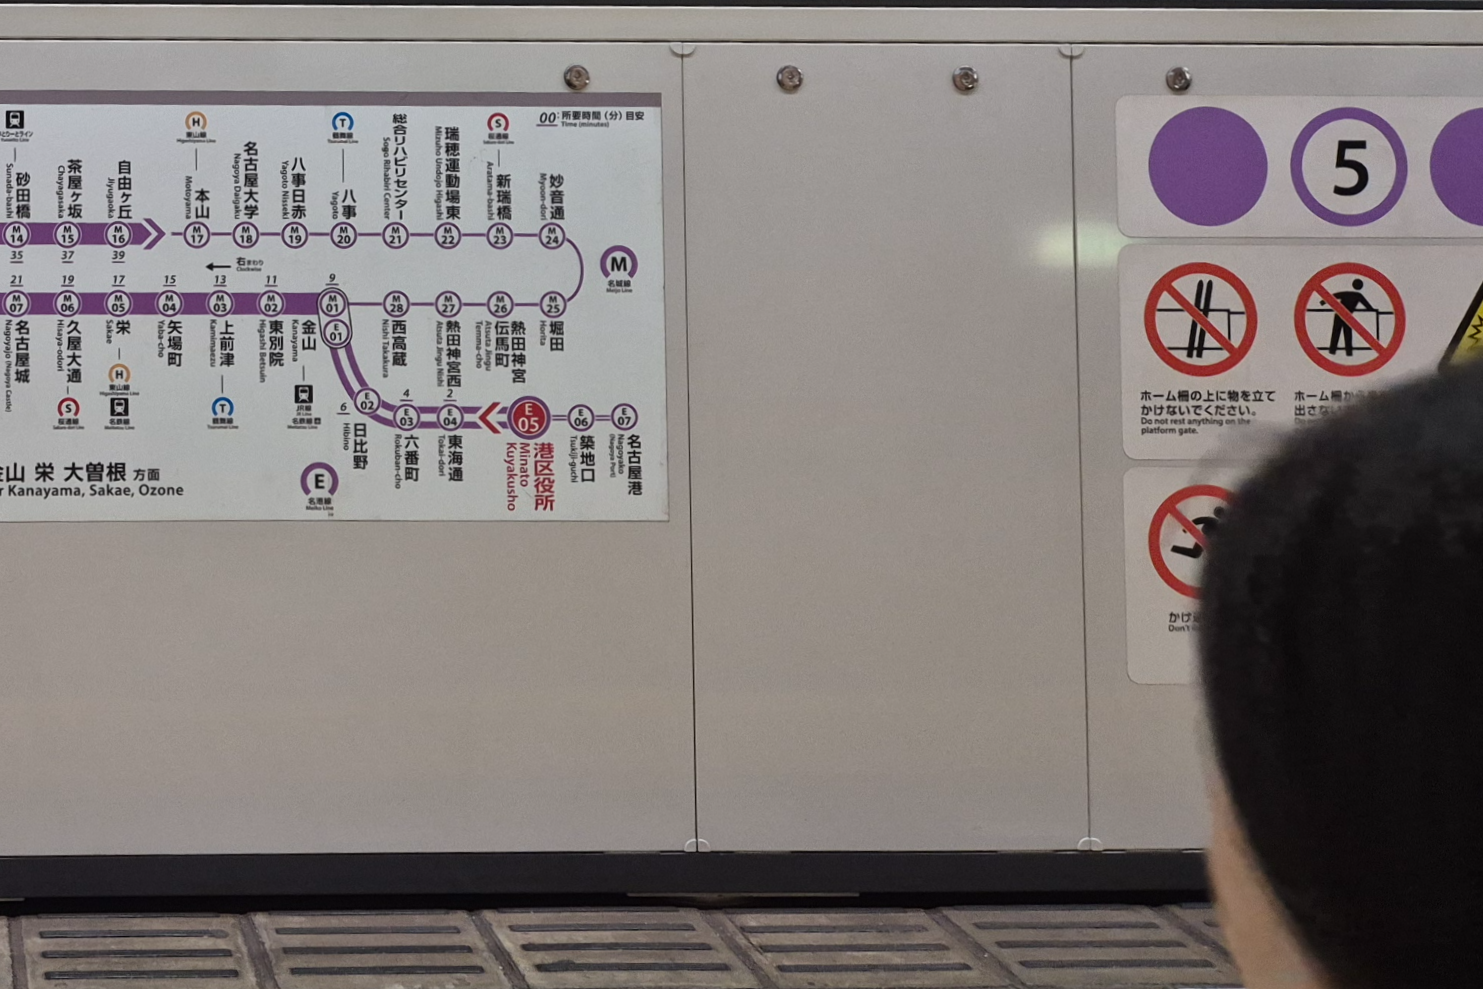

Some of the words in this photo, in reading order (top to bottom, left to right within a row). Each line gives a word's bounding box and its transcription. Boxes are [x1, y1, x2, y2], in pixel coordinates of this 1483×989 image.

[193, 117, 200, 126] H
[339, 118, 346, 127] T
[495, 119, 502, 128] S
[232, 153, 241, 185] Nagoya
[243, 141, 259, 219] 名古屋大学
[280, 160, 289, 189] Yagoto
[392, 114, 408, 220] 総合リハビリセンター
[445, 126, 460, 220] 瑞穂運動場東
[1333, 140, 1369, 196] 5
[16, 172, 30, 219] 砂田橋
[56, 165, 65, 219] Chayagasaka
[106, 177, 115, 219] Jiyugaoka
[184, 176, 193, 219] Motoyama
[195, 188, 210, 219] 本山
[232, 186, 241, 219] Daigaku
[291, 157, 306, 220] 八事日赤
[486, 161, 495, 221] Aratama-bashi
[496, 174, 511, 221] 新瑞橋
[538, 173, 547, 221] Myoon-dori
[549, 174, 565, 220] 妙音通
[330, 191, 339, 219] Yagoto
[342, 189, 357, 220] 八事
[10, 251, 23, 260] 35
[61, 251, 74, 260] 37
[112, 251, 125, 260] 39
[236, 257, 264, 266] 右まわり
[611, 257, 627, 272] M
[10, 275, 23, 284] 21
[62, 275, 74, 284] 19
[113, 275, 125, 284] 17
[164, 275, 176, 284] 15
[214, 275, 227, 284] 13
[266, 275, 277, 284] 11
[329, 274, 336, 282] 9
[3, 320, 12, 359] Nagoyajo
[106, 320, 114, 344] Sakae
[116, 320, 131, 335] 栄
[157, 320, 165, 358] Yaba-cho
[257, 320, 266, 350] Higashi
[290, 320, 299, 362] Kanayama
[301, 320, 316, 351] 金山
[436, 321, 444, 345] Atsuta
[549, 321, 564, 352] 堀田
[14, 320, 30, 384] 名古屋城
[55, 320, 64, 372] Hisaya-odori
[66, 320, 82, 384] 久屋大通
[167, 320, 182, 367] 矢場町
[220, 320, 235, 367] 上前津
[268, 320, 284, 367] 東別院
[392, 320, 407, 367] 西高蔵
[435, 347, 444, 368] Jingu
[446, 320, 462, 387] 熱田神宮西
[475, 321, 483, 369] Temma-cho
[495, 321, 509, 368] 伝馬町
[511, 321, 526, 384] 熱田神宮
[483, 349, 491, 371] Jingu
[340, 403, 347, 411] 6
[403, 389, 410, 397] 4
[447, 389, 453, 398] 2
[1140, 390, 1276, 402] ホーム柵の上に物を立て
[518, 418, 539, 432] 05
[525, 404, 533, 415] E
[1141, 405, 1256, 417] かけないでください。
[1188, 418, 1223, 427] anything
[353, 423, 368, 470] 日比野
[1141, 427, 1176, 435] platform
[404, 434, 419, 482] 六番町
[448, 435, 463, 482] 東海通
[519, 442, 530, 487] Minato
[569, 435, 578, 483] Tsukiji-guchi
[580, 435, 595, 483] 築地口
[616, 434, 624, 475] Nagoyako
[627, 434, 642, 495] 名古屋港
[35, 462, 55, 482] 栄
[64, 462, 127, 482] 大曽根
[133, 468, 160, 482] 方面
[315, 474, 325, 489] E
[504, 442, 518, 511] Kuyakusho
[534, 442, 555, 511] 港区役所
[8, 485, 85, 498] Kanayama,
[89, 485, 135, 498] Sakae,
[139, 485, 184, 497] Ozone
